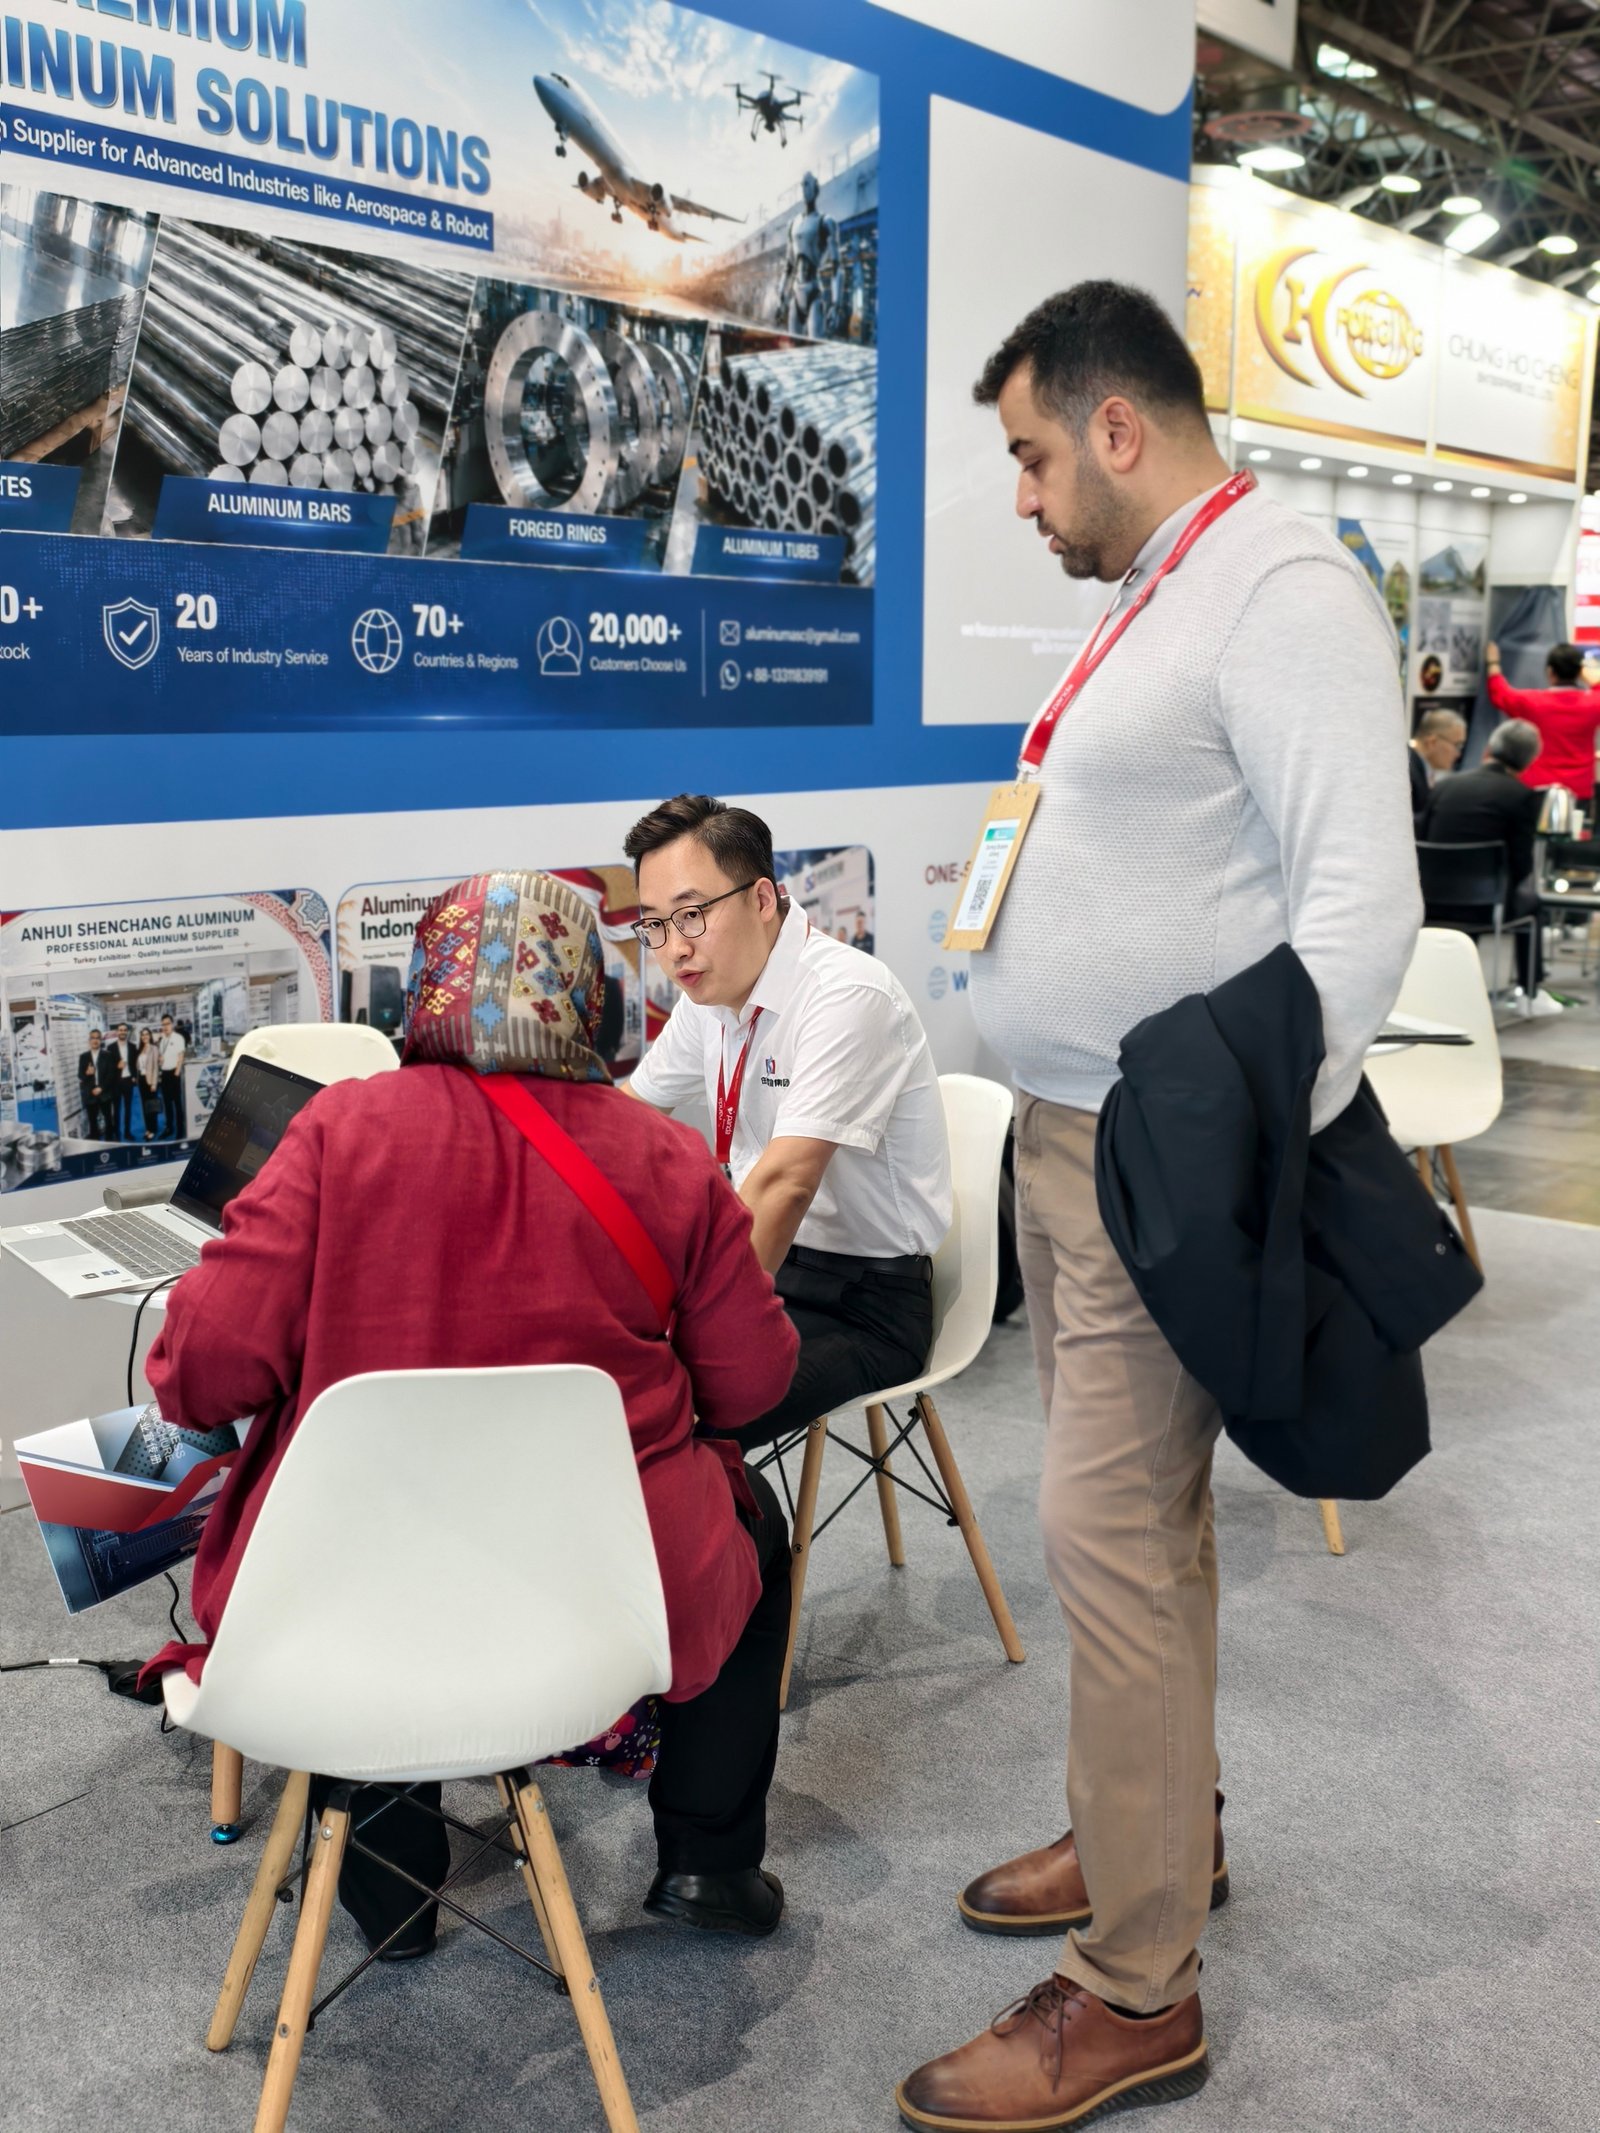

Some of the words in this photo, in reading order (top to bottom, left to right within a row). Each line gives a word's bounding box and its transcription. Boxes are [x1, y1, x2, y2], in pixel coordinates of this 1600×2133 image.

[0, 15, 177, 124] INUM
[196, 66, 491, 197] SOLUTIONS
[13, 117, 96, 158] Supplier
[100, 137, 128, 165] for
[133, 145, 223, 186] Advanced
[227, 170, 309, 202] Industries
[313, 183, 342, 209] like
[345, 191, 427, 227] Aerospace
[430, 209, 442, 231] &
[445, 212, 489, 241] Robot
[208, 492, 302, 519] ALUMINUM
[308, 500, 352, 523] BARS
[509, 518, 563, 541] FORGED
[566, 524, 606, 544] RINGS
[722, 536, 782, 558] ALUMINUM
[785, 541, 819, 560] TUBES
[0, 585, 43, 624] 0+
[175, 593, 218, 630] 20
[412, 604, 464, 638] 70+
[589, 611, 682, 648] 20,000+
[177, 646, 214, 664] Years
[216, 647, 229, 663] of
[232, 648, 281, 668] Industry
[284, 649, 328, 665] Service
[413, 652, 465, 669] Countries
[466, 652, 475, 669] &
[477, 654, 519, 672] Regions
[590, 657, 639, 673] Customers
[640, 658, 673, 673] Choose
[674, 658, 687, 674] Us
[361, 892, 441, 916] Aluminu
[21, 924, 72, 942] ANHUI
[77, 915, 172, 937] SHENCHANG
[176, 908, 255, 928] ALUMINUM
[46, 938, 128, 955] PROFESSIONAL
[132, 932, 189, 946] ALUMINUM
[191, 928, 239, 941] SUPPLIER
[73, 956, 97, 966] Turkey
[98, 952, 131, 963] Exhibition
[137, 948, 161, 960] Quality
[162, 946, 194, 956] Aluminum
[195, 943, 223, 952] Solutions
[136, 1412, 162, 1465] 企业宣传册
[149, 1407, 175, 1462] BROCHURE
[165, 1421, 186, 1460] INESS
